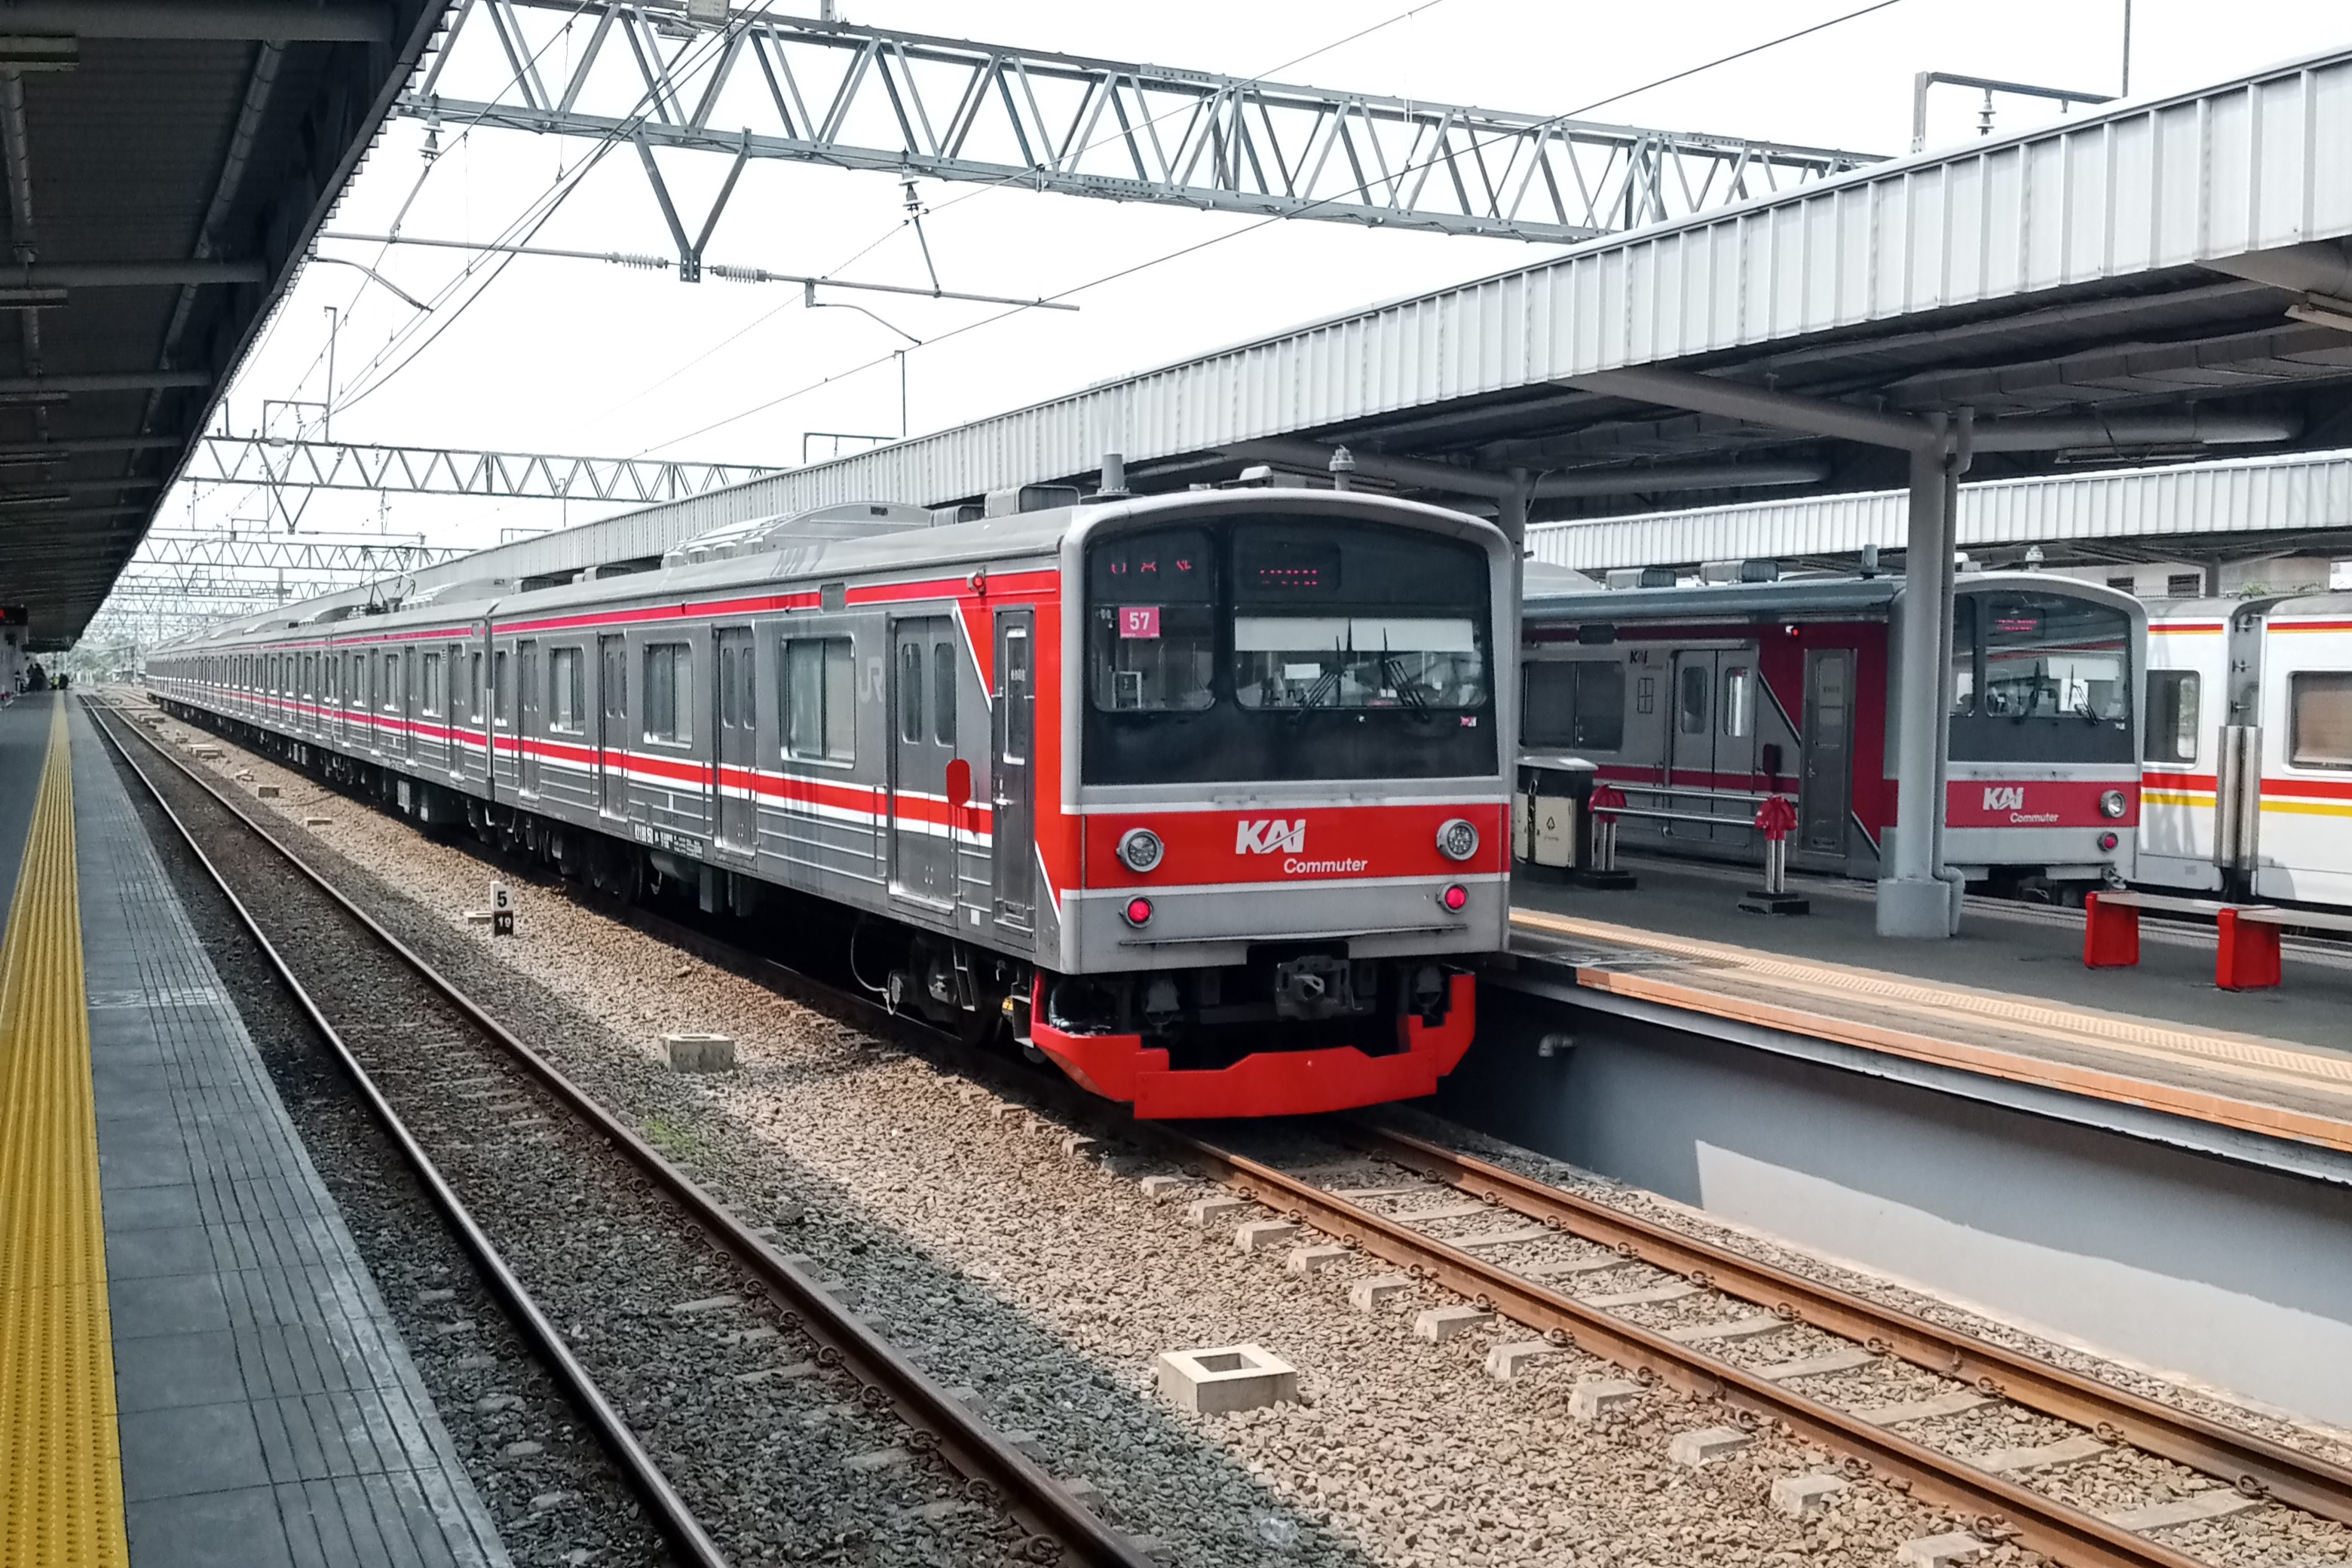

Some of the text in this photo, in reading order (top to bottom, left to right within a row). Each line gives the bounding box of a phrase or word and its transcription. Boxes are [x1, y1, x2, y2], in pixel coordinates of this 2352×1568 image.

[1129, 611, 1150, 630] 57
[859, 655, 884, 704] JR
[1983, 787, 2024, 810] KAI
[2010, 812, 2059, 823] Commuter
[1236, 819, 1306, 855] KAI
[1284, 858, 1368, 874] Commuter
[497, 891, 507, 908] 5
